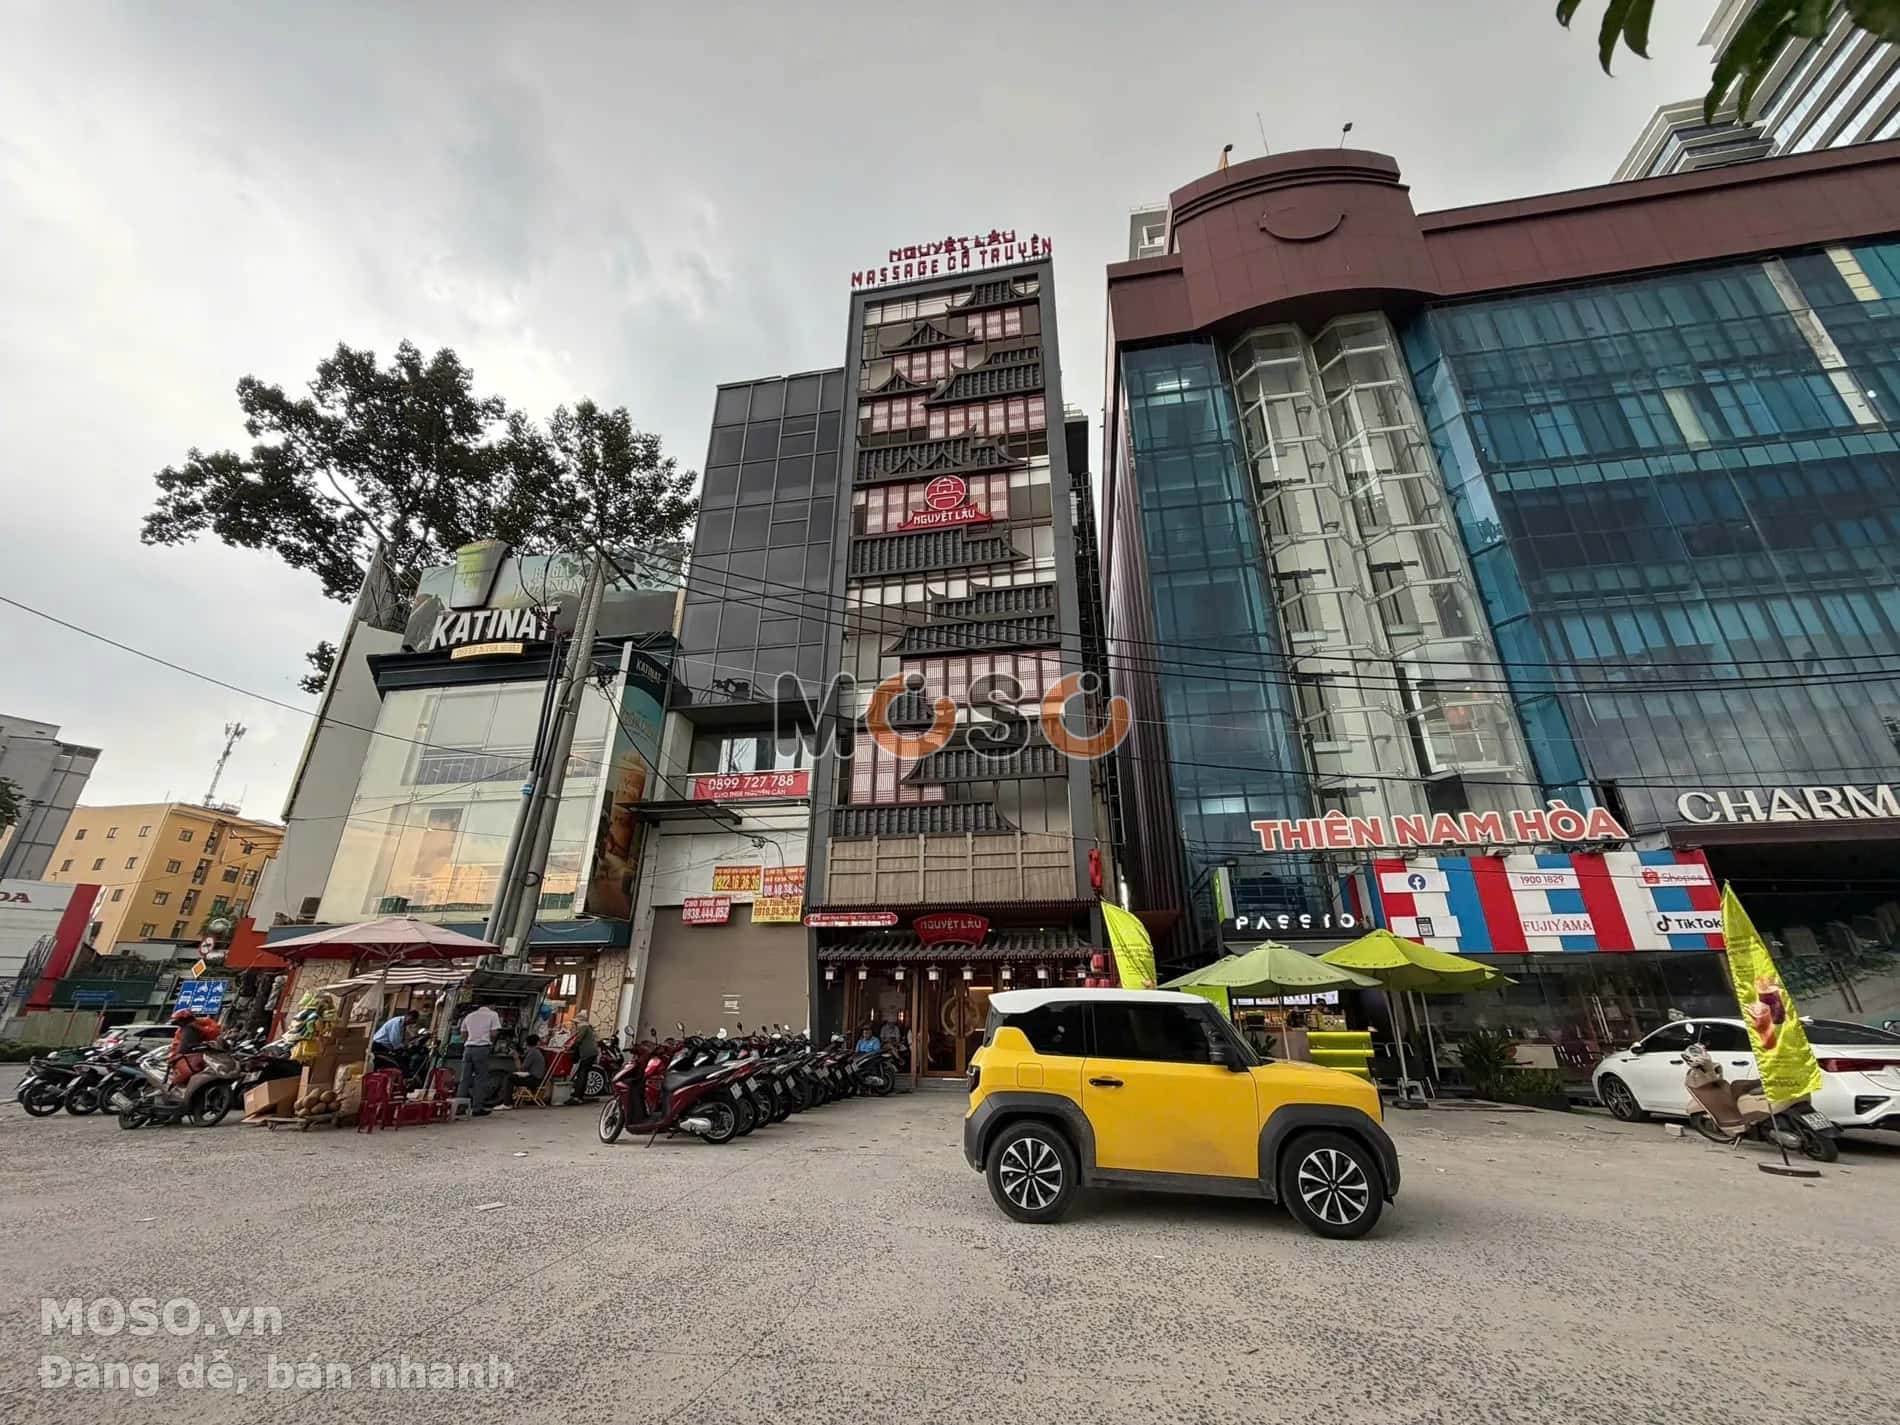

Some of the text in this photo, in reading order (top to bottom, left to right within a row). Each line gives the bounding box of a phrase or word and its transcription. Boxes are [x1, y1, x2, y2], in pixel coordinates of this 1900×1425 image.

[851, 259, 939, 287] MASSAGE
[955, 507, 976, 520] LÂU
[429, 605, 561, 651] KATINAT
[708, 774, 794, 791] 0899 727 788
[1678, 783, 1900, 824] CHARM
[1252, 798, 1630, 851] THIÊN NAM HÒA
[1520, 874, 1565, 885] 1900 1829
[1523, 918, 1593, 932] FUJIYAMA
[1674, 917, 1722, 929] TikTok
